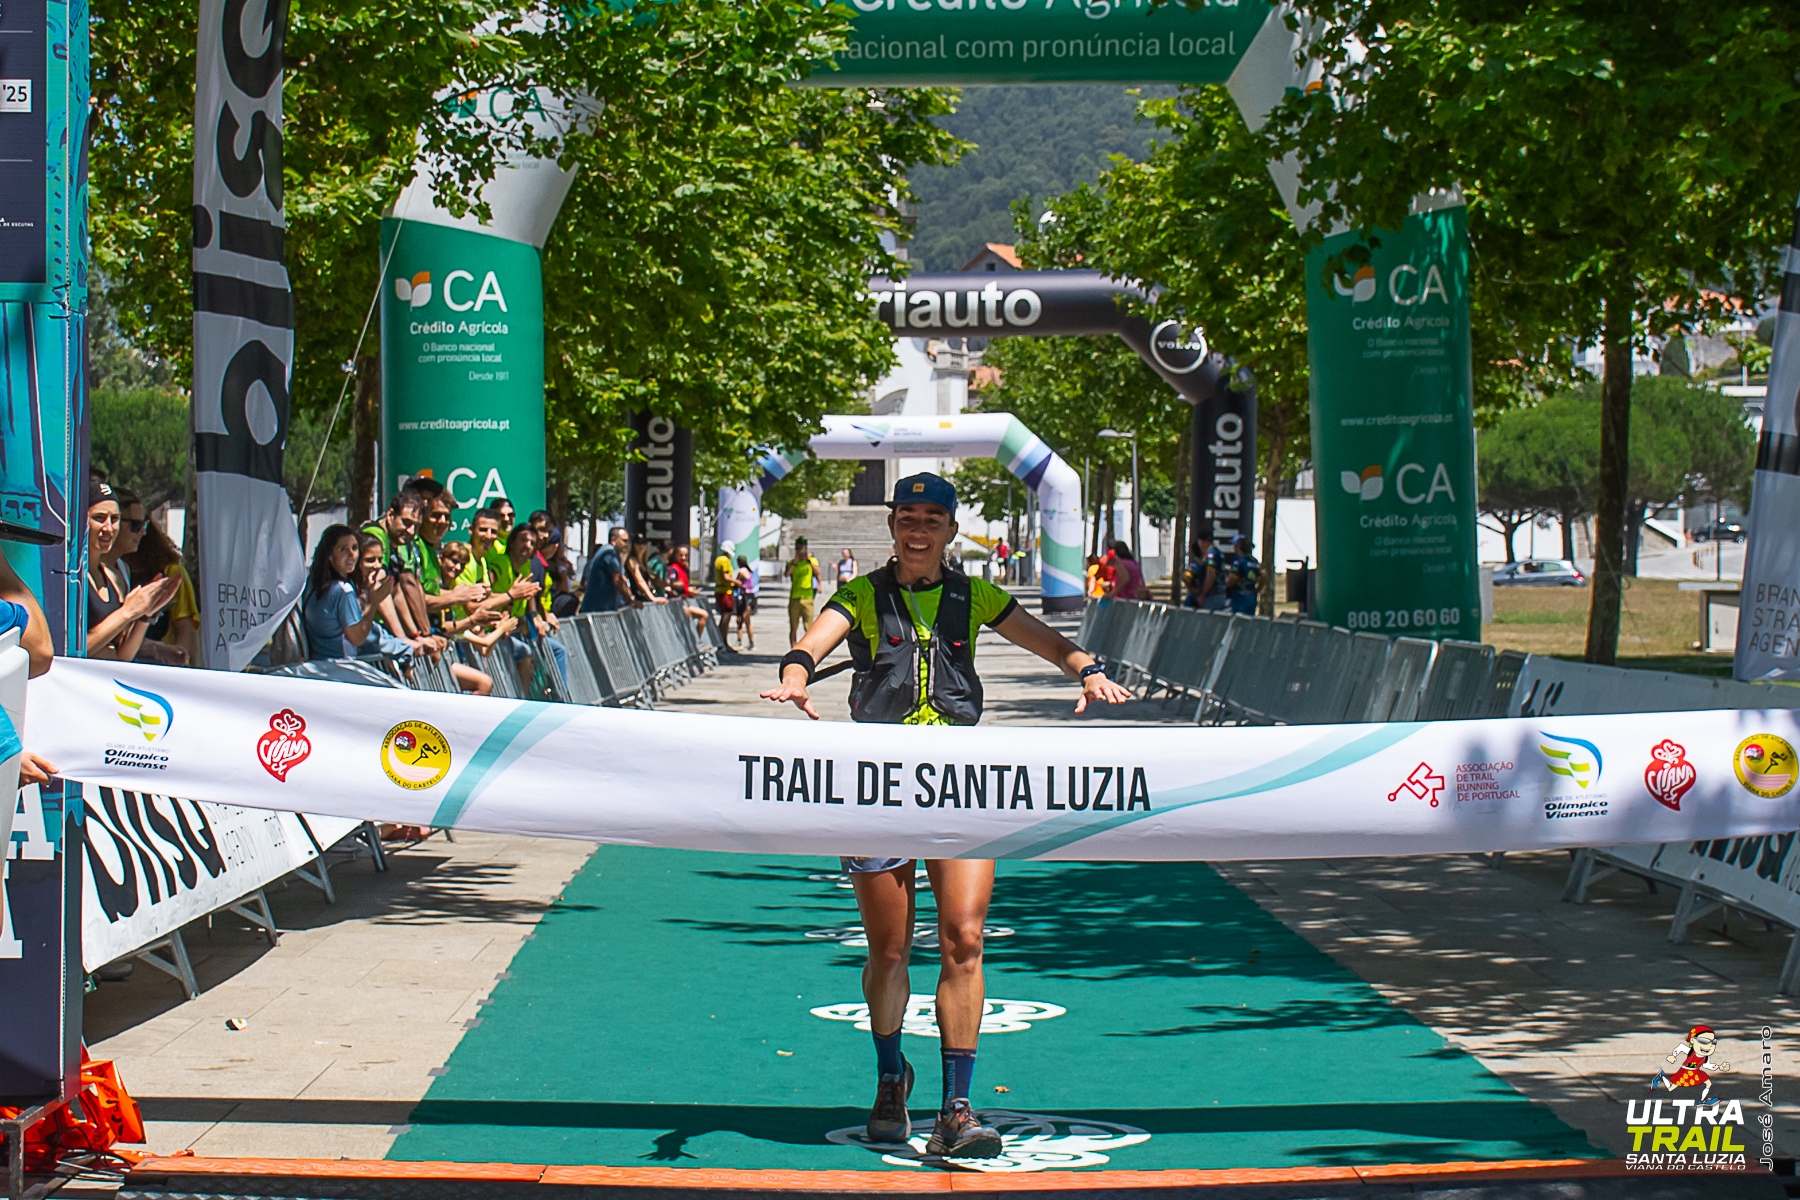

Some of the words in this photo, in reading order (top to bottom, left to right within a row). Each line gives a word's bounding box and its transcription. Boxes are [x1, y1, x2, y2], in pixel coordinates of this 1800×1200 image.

[955, 40, 1014, 59] com
[1023, 33, 1160, 62] pronúncia
[1169, 31, 1236, 56] local
[489, 87, 547, 122] CA
[443, 270, 508, 312] CA
[1389, 264, 1448, 305] CA
[409, 321, 455, 335] Crédito
[458, 321, 509, 336] Agrícola
[1353, 316, 1400, 330] Crédito
[423, 342, 430, 352] O
[431, 342, 458, 352] Banco
[459, 343, 495, 352] nacional
[437, 353, 480, 363] pronúncia
[482, 353, 502, 363] local
[398, 418, 510, 432] www.creditoagricola.pt
[447, 467, 508, 509] CA
[638, 416, 675, 556] riauto
[1396, 463, 1455, 504] CA
[1360, 514, 1408, 528] Crédito
[218, 583, 272, 608] BRAND
[219, 607, 274, 630] STRAT
[1348, 611, 1381, 629] 808
[1385, 610, 1409, 628] 20
[1413, 608, 1437, 626] 60
[1440, 607, 1460, 625] 60
[424, 724, 448, 754] ATLETISMO
[104, 749, 169, 761] Olímpico
[260, 735, 309, 766] VIANA
[104, 757, 168, 770] Vianense
[1456, 761, 1514, 773] ASSOCIAÇÃO
[402, 781, 412, 789] DO
[413, 774, 441, 789] CASTELO
[738, 754, 844, 805] TRAIL
[857, 760, 903, 807] DE
[915, 762, 1034, 811] SANTA
[1046, 765, 1151, 811] LUZIA
[1457, 774, 1468, 782] DE
[1470, 773, 1495, 781] TRAIL
[1647, 763, 1694, 796] VIANA
[1457, 782, 1499, 792] RUNNING
[1457, 792, 1470, 802] DE
[1472, 790, 1521, 801] PORTUGAL
[1544, 801, 1608, 811] Olímpico
[1545, 810, 1608, 819] Vianense
